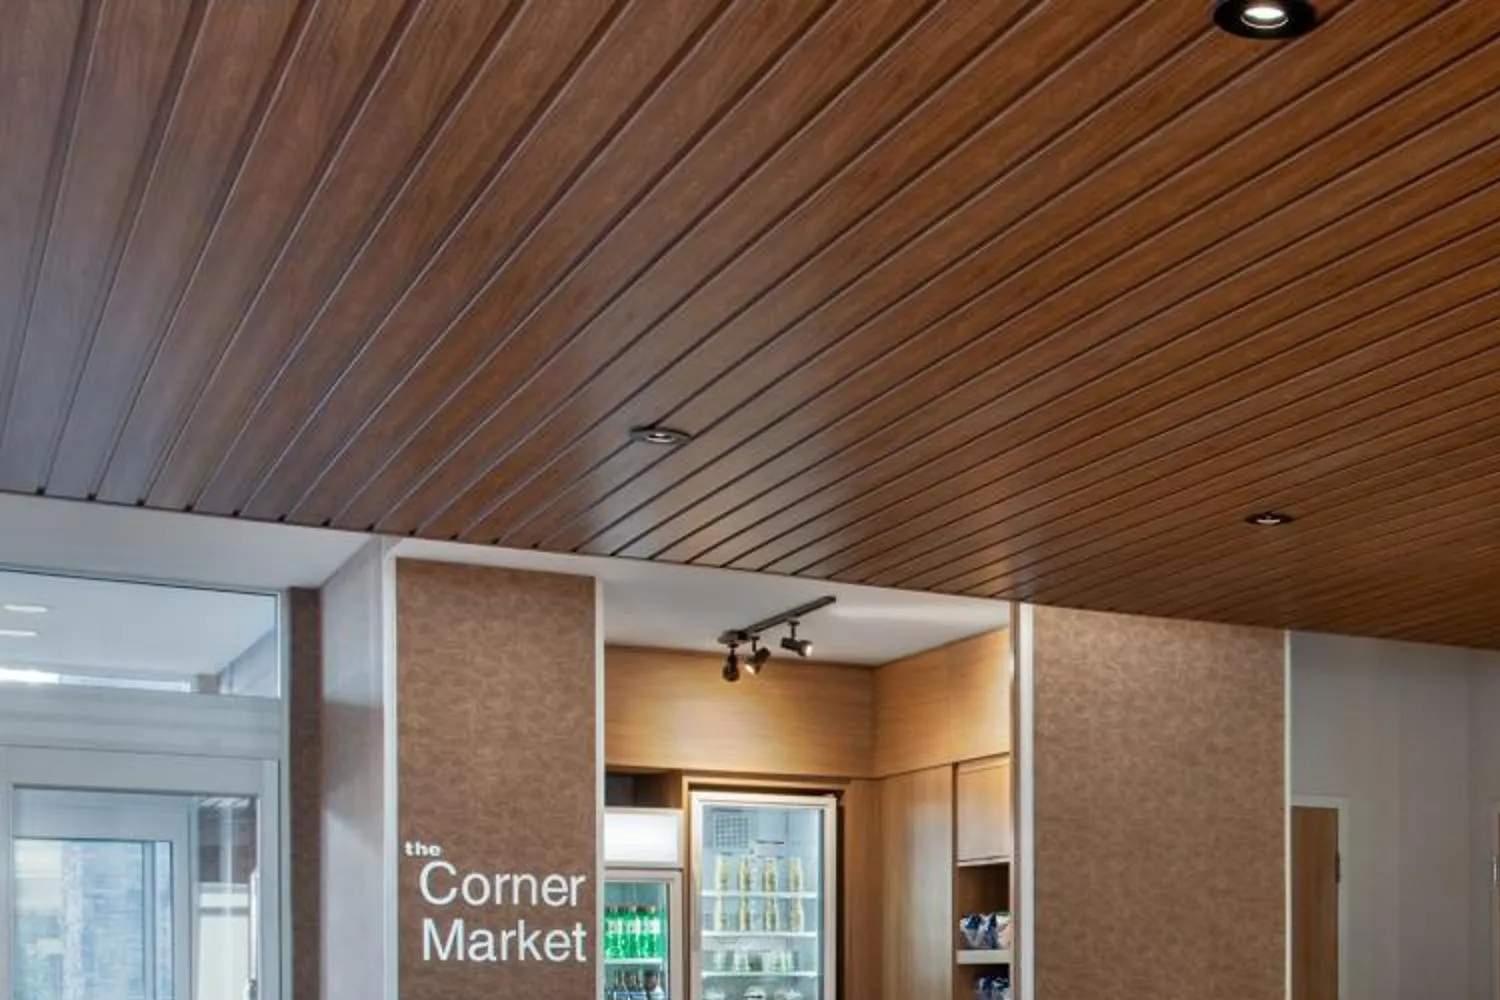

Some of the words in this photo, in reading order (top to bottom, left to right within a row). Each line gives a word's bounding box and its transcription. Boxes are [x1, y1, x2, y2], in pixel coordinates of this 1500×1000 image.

[405, 841, 442, 857] the
[418, 860, 587, 907] Corner
[423, 918, 587, 962] Market
